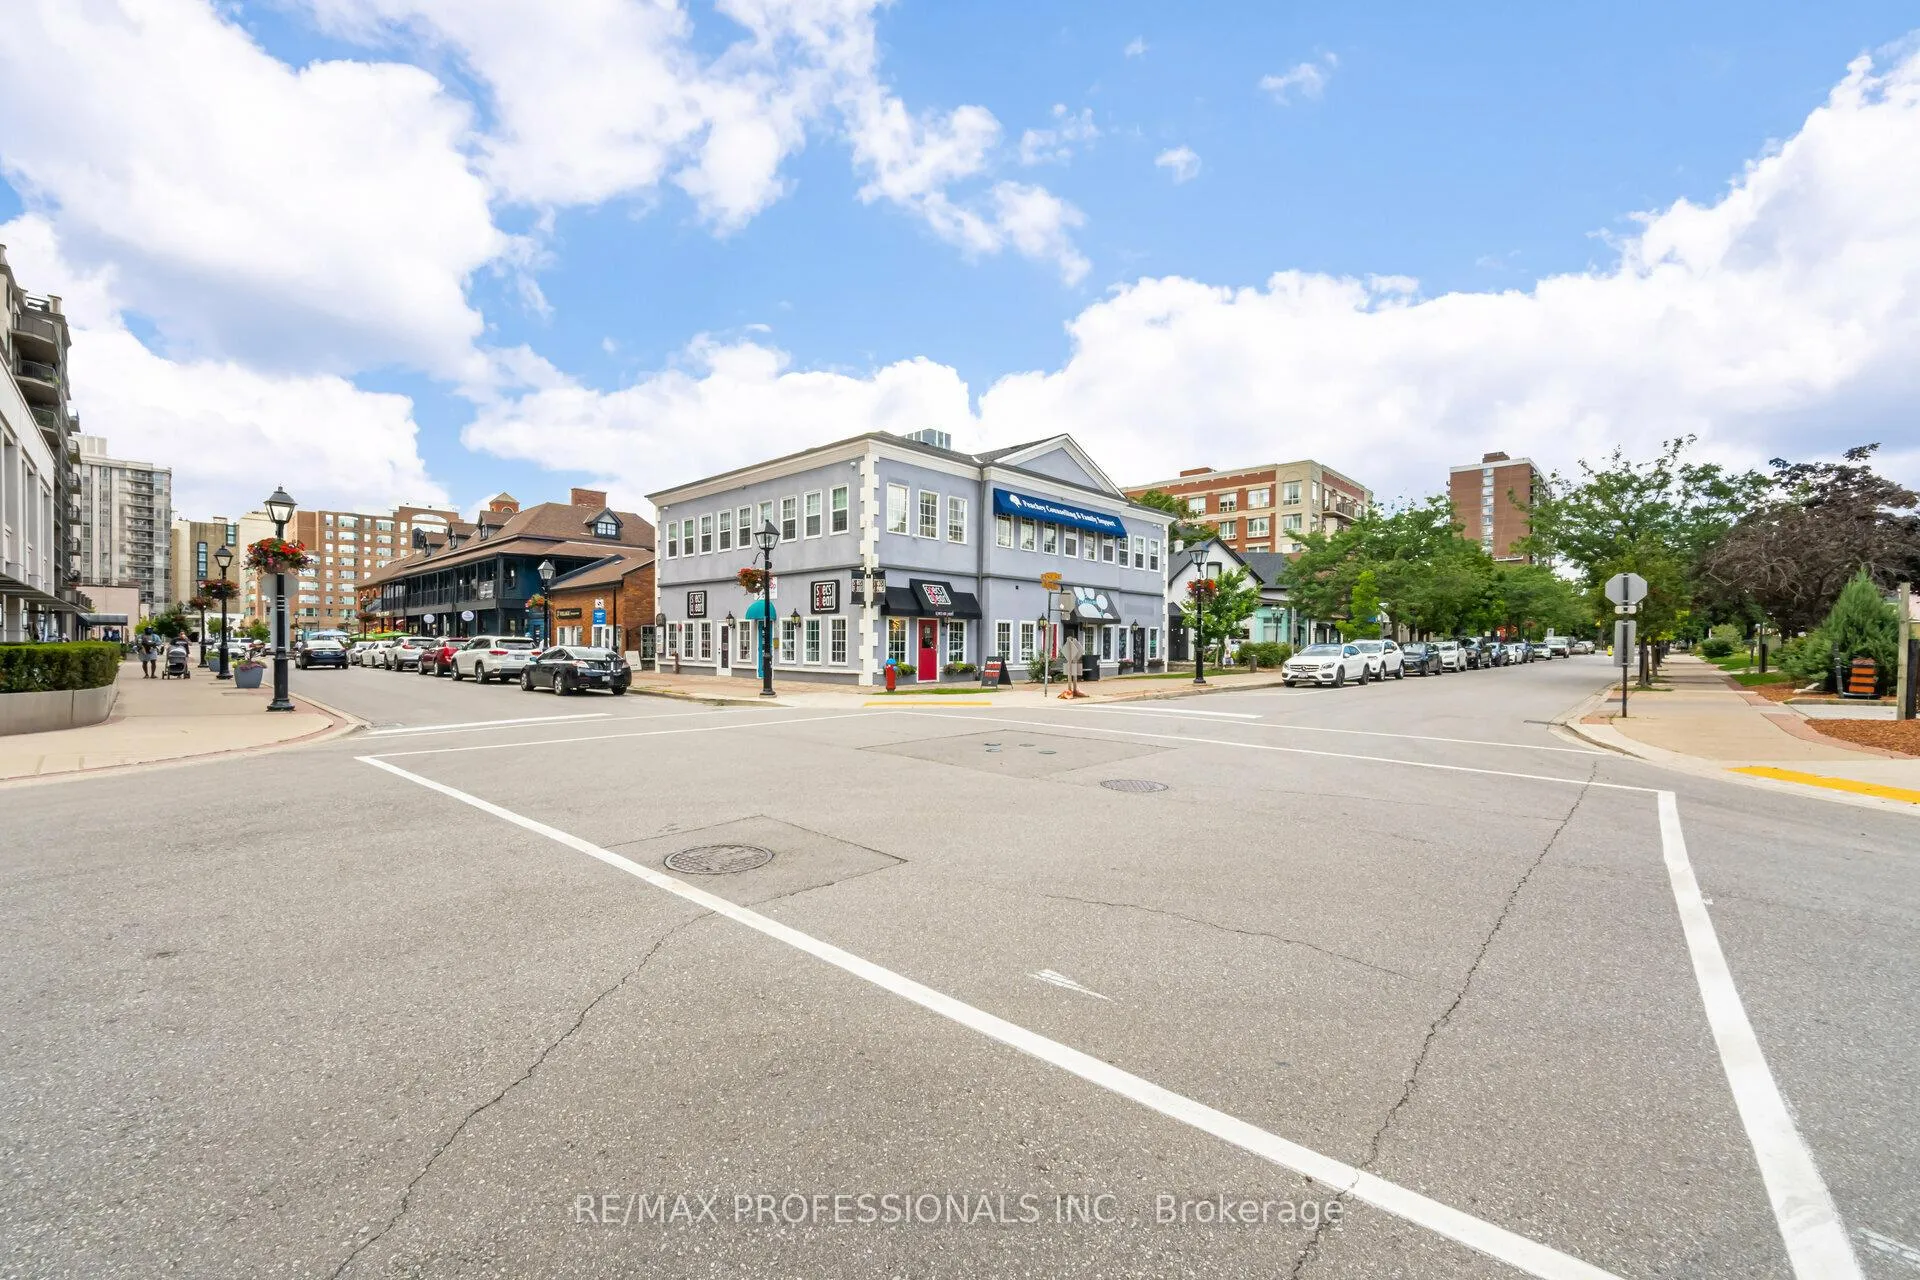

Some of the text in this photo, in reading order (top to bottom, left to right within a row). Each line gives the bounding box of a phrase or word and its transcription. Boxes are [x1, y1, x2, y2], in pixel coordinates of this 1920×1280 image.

[1022, 500, 1045, 512] Peachey
[1046, 505, 1077, 519] Counselling
[1097, 517, 1116, 527] Support
